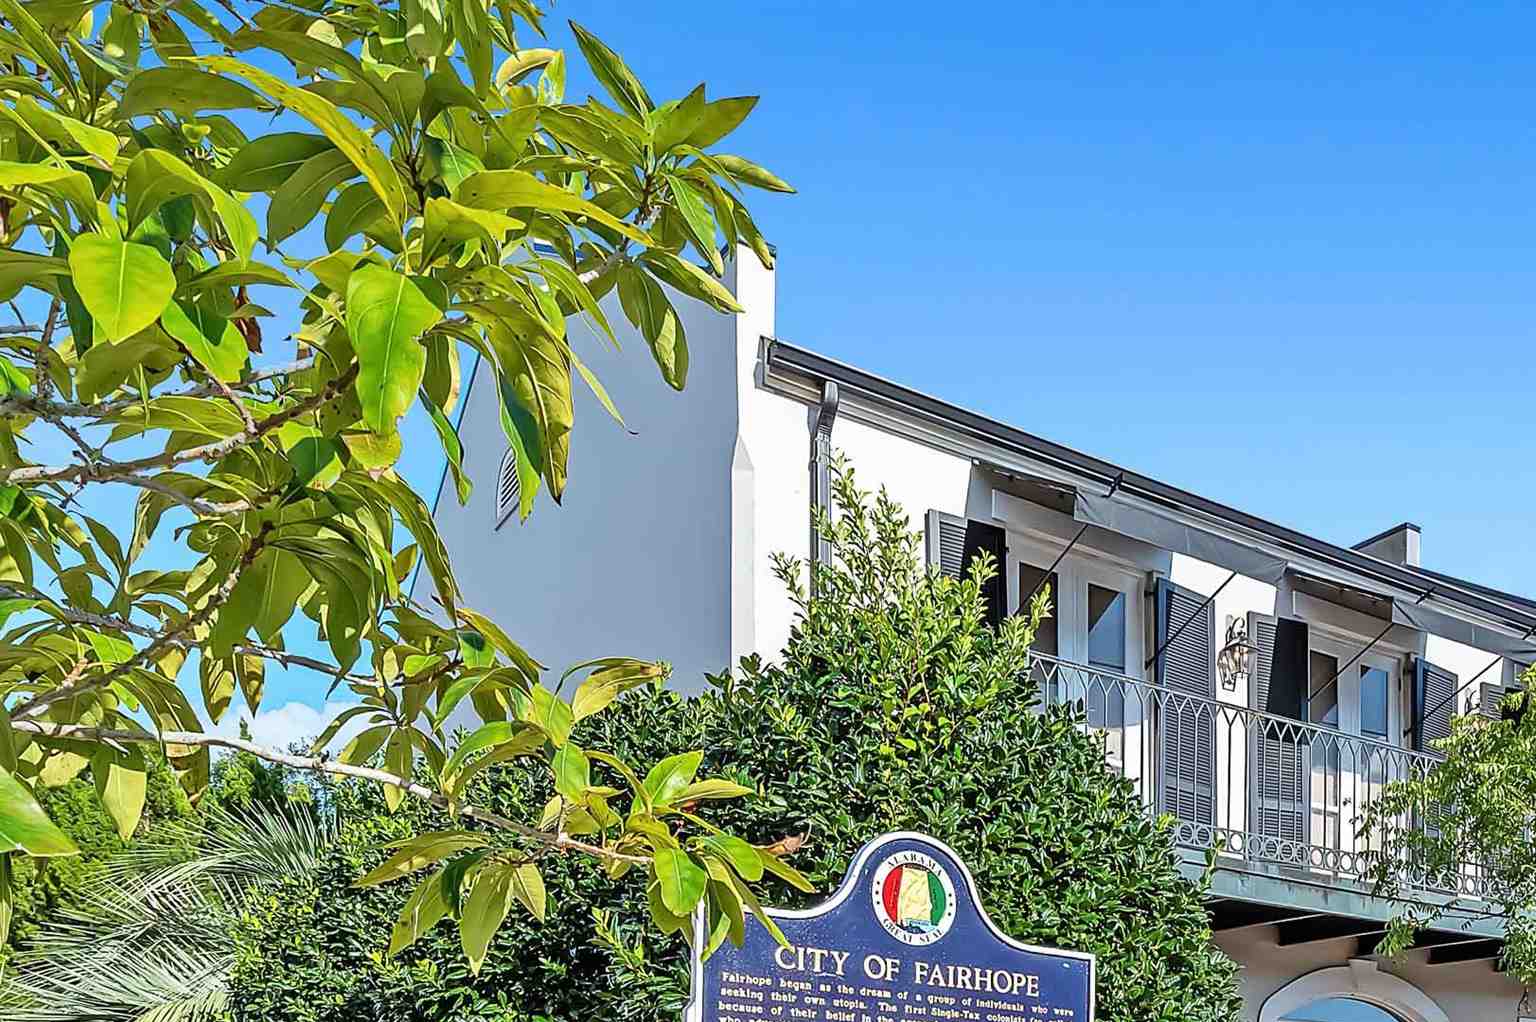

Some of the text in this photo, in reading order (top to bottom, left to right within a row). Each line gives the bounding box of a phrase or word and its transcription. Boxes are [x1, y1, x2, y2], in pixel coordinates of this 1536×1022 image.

[775, 945, 1040, 997] CITY OF FAIRHOPE
[718, 1000, 762, 1013] because
[770, 1005, 782, 1015] of
[790, 1007, 816, 1018] their
[722, 971, 771, 988] Fairhope
[837, 983, 854, 993] the
[859, 986, 890, 997] dream
[897, 990, 908, 999] of
[927, 995, 955, 1006] group
[961, 996, 971, 1005] of
[1031, 1004, 1048, 1013] who
[771, 991, 797, 1002] their
[804, 996, 825, 1005] own
[878, 1001, 896, 1011] The
[931, 1007, 980, 1022] Single-Tax
[986, 1012, 1025, 1022] colonists
